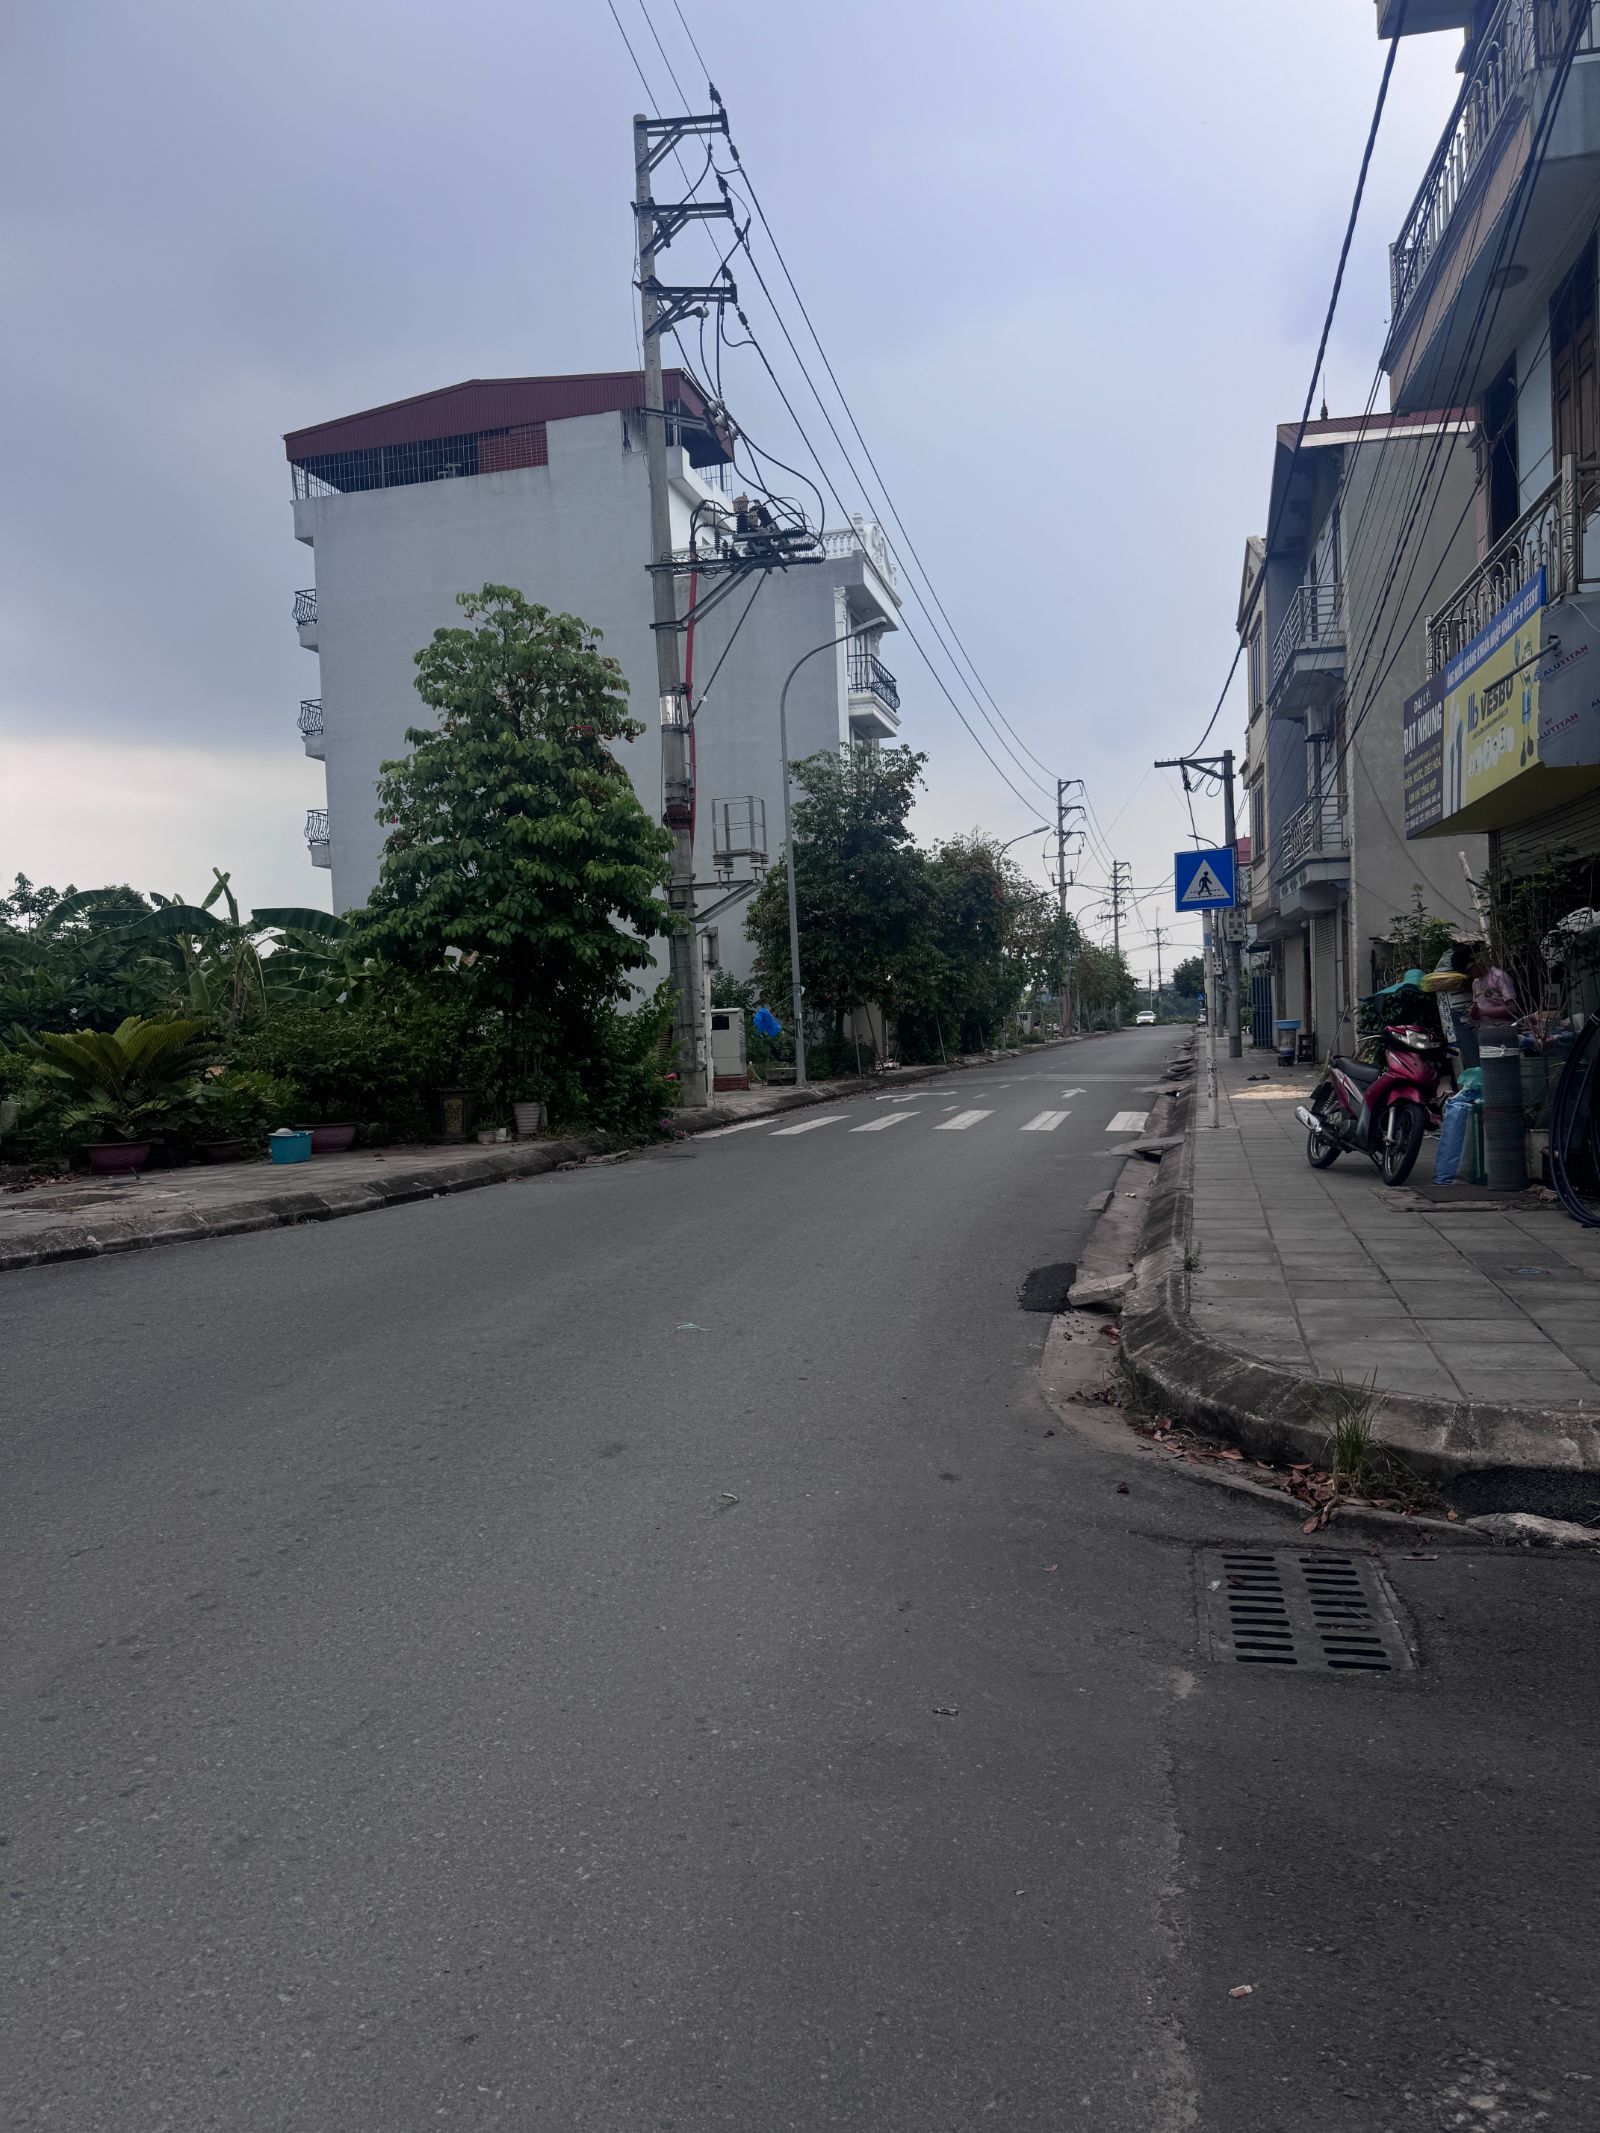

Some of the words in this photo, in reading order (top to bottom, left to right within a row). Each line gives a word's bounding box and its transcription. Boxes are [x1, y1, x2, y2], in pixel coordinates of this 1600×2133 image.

[1543, 644, 1589, 677] ALUTITAN
[1404, 722, 1416, 758] ĐẠT
[1417, 701, 1442, 746] NHUNG
[1538, 713, 1579, 741] LUTITAN
